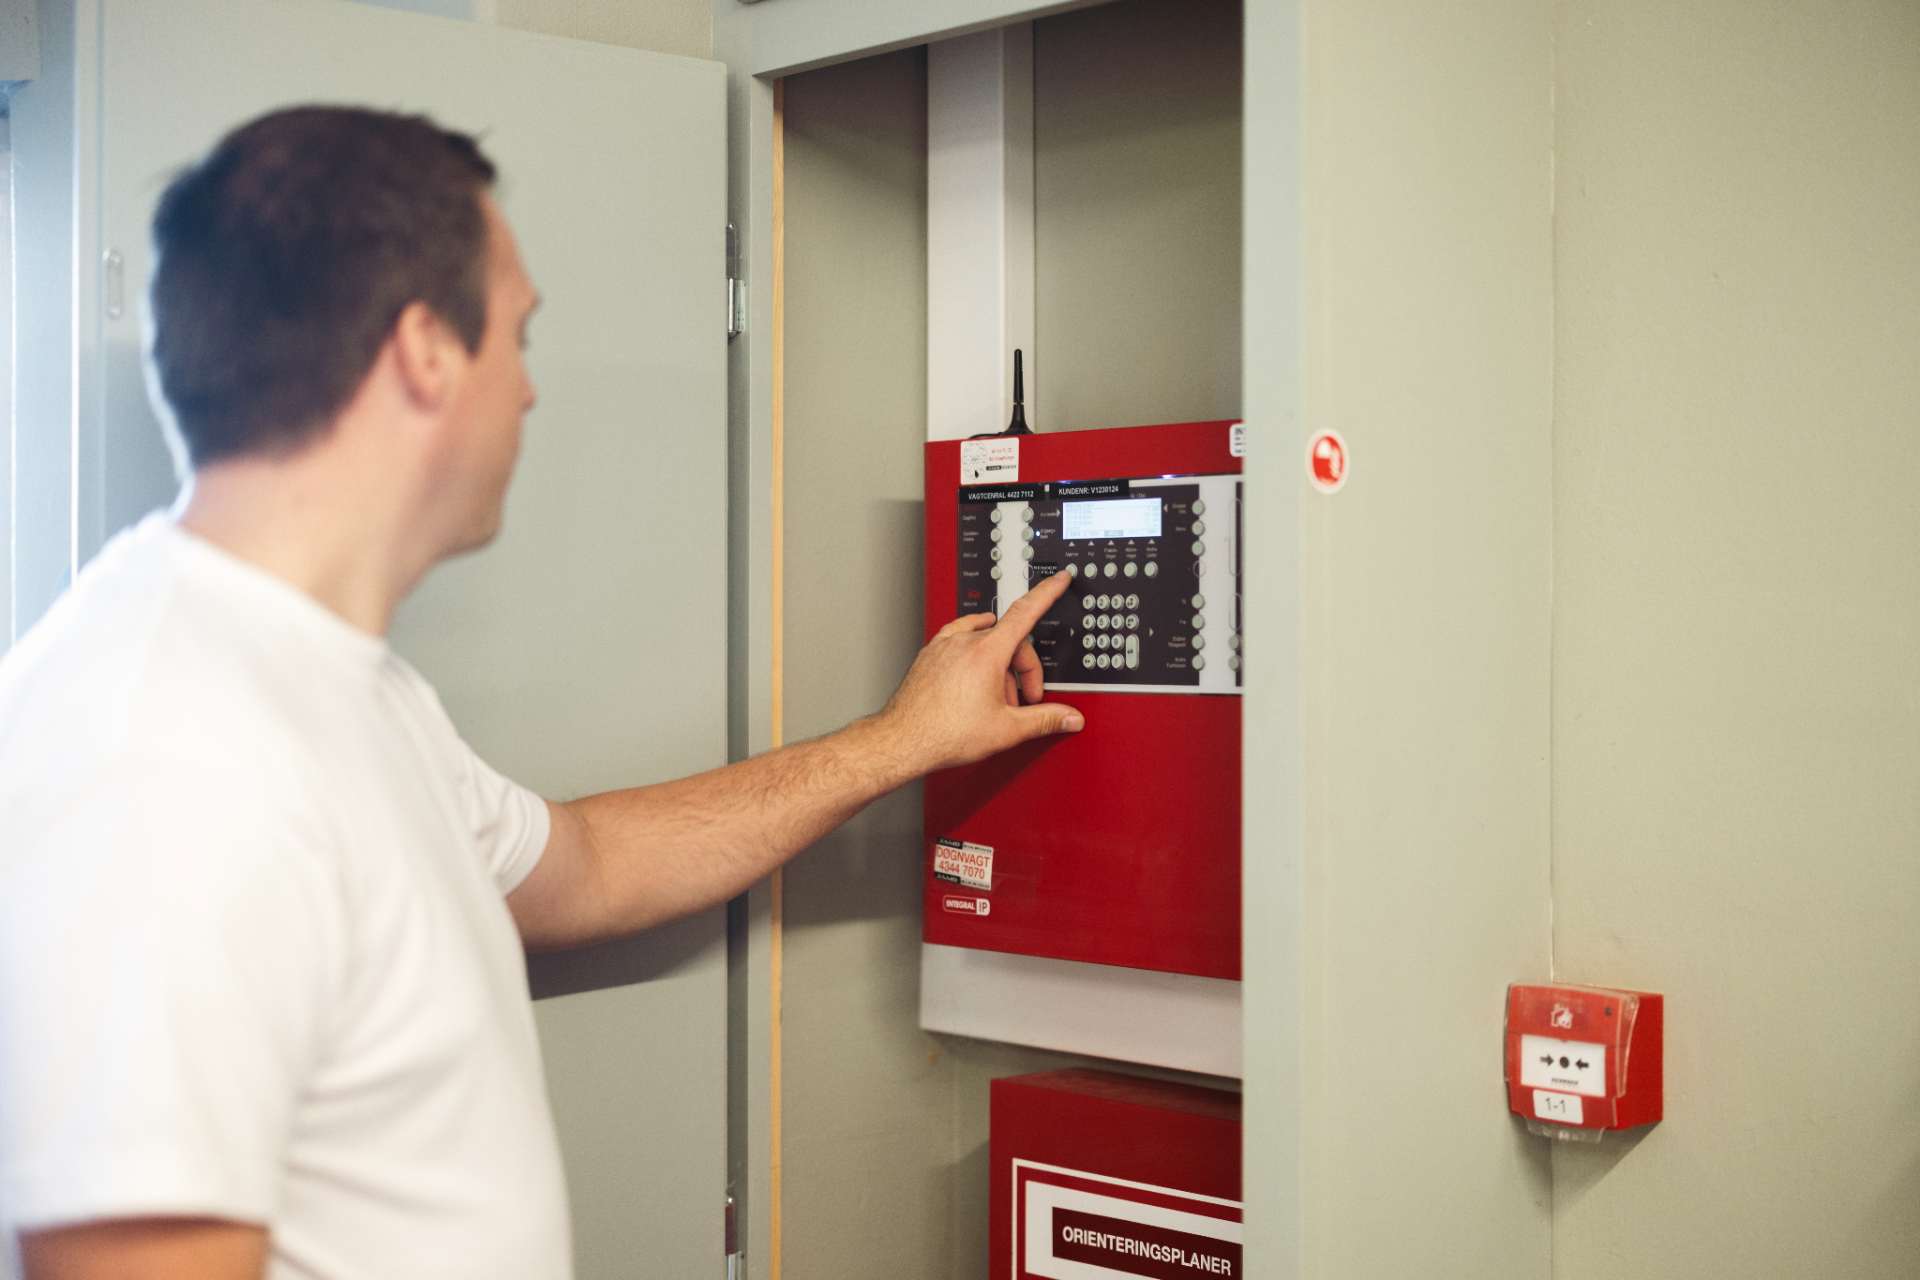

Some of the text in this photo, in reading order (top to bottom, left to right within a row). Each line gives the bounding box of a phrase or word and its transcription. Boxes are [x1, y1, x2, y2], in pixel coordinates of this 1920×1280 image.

[1020, 490, 1034, 498] 7112
[1058, 487, 1090, 496] KUNDENR:
[962, 865, 985, 879] 7070
[945, 900, 988, 913] INTEGRAL IP
[1545, 1097, 1566, 1113] 1-1
[1062, 1226, 1231, 1276] ORIENTERINGSPLANER
